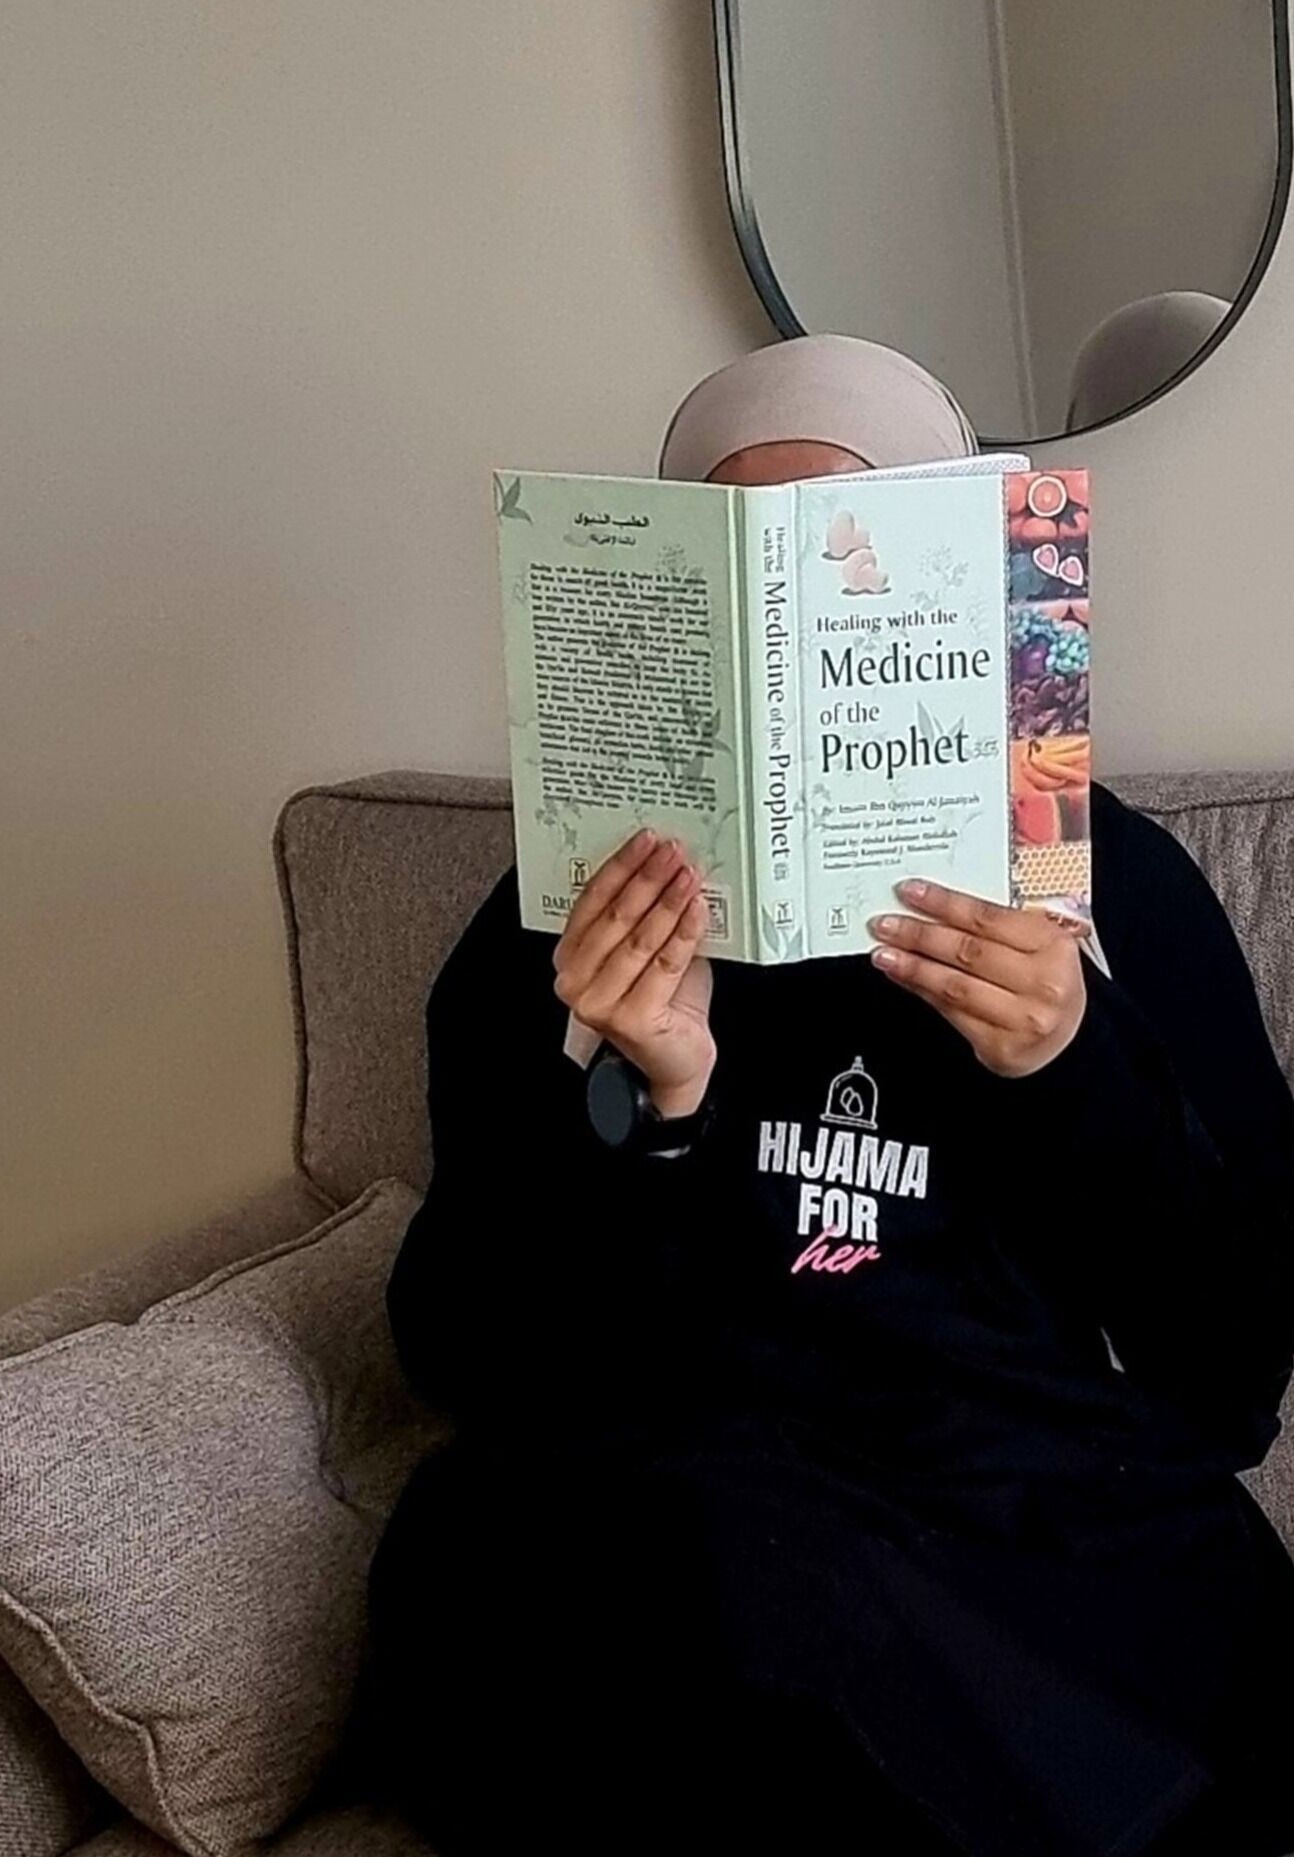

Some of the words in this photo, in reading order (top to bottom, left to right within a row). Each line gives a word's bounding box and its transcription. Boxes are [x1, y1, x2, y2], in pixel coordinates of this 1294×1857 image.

[764, 555, 775, 574] the
[764, 581, 790, 704] Medicine
[817, 614, 882, 633] Healing
[887, 610, 925, 629] with
[931, 608, 958, 625] the
[820, 639, 991, 689] Medicine
[769, 707, 787, 725] of
[819, 701, 844, 726] of
[846, 700, 880, 723] the
[770, 726, 787, 751] the
[820, 725, 969, 780] Prophet
[764, 753, 794, 858] Prophet
[757, 1121, 930, 1199] HIJAMA
[797, 1182, 879, 1242] FOR
[790, 1223, 881, 1274] her
